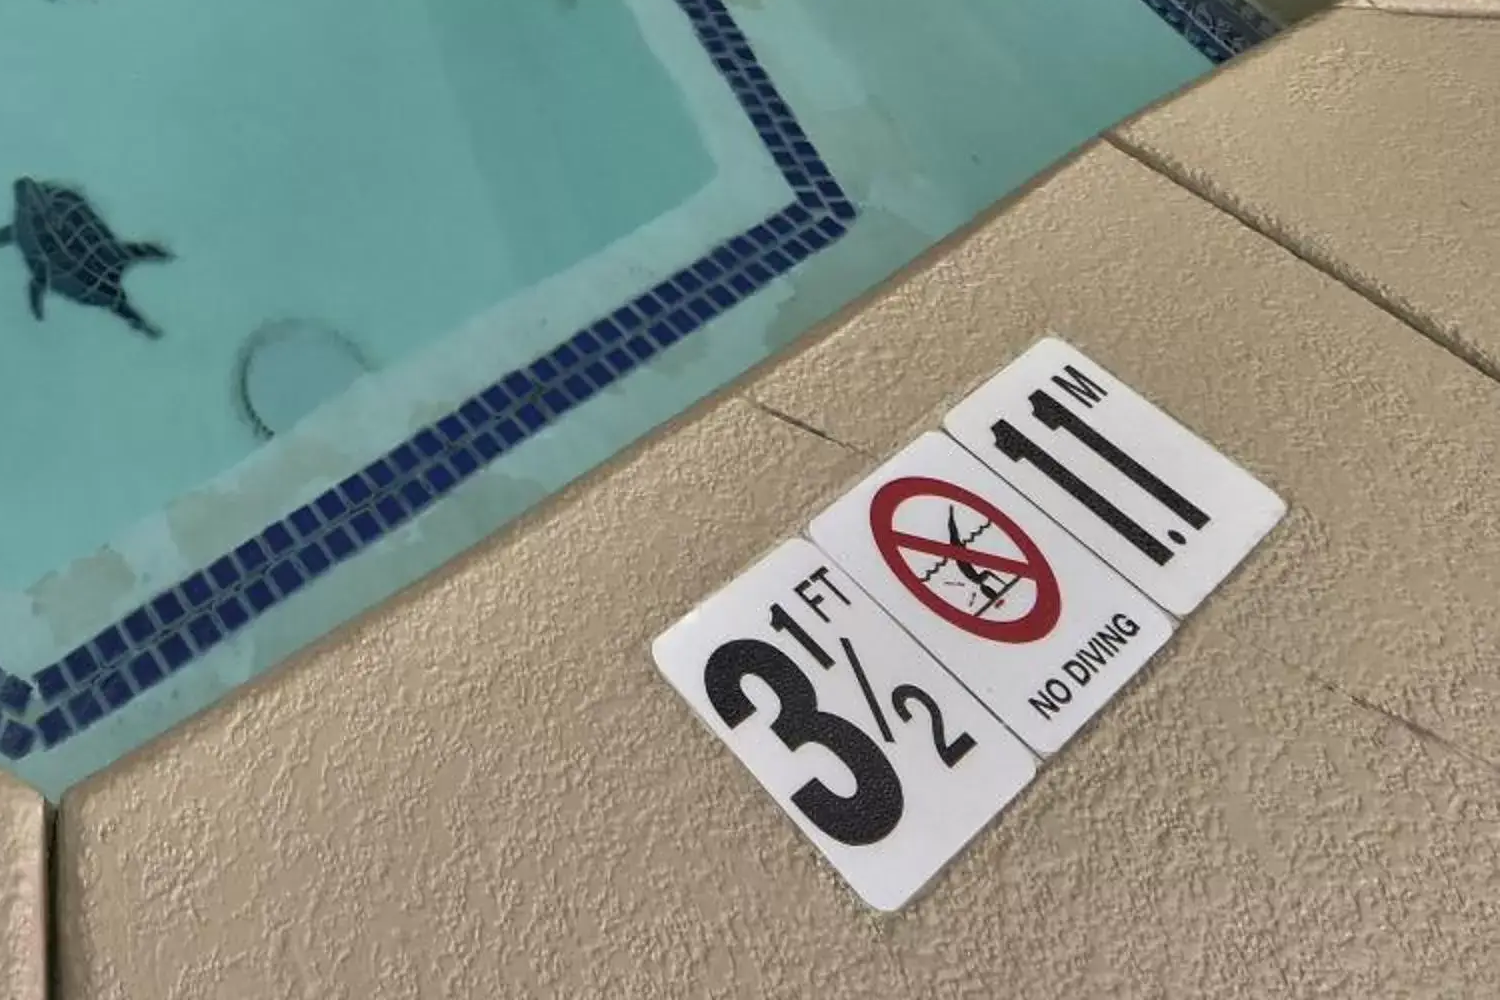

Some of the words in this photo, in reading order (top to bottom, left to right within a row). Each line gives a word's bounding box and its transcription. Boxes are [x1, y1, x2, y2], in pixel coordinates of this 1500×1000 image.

[1051, 364, 1108, 411] M
[990, 388, 1211, 567] 1.1
[793, 565, 853, 623] FT
[1028, 676, 1073, 720] NO
[1062, 612, 1140, 687] DIVING
[703, 638, 905, 847] 3
